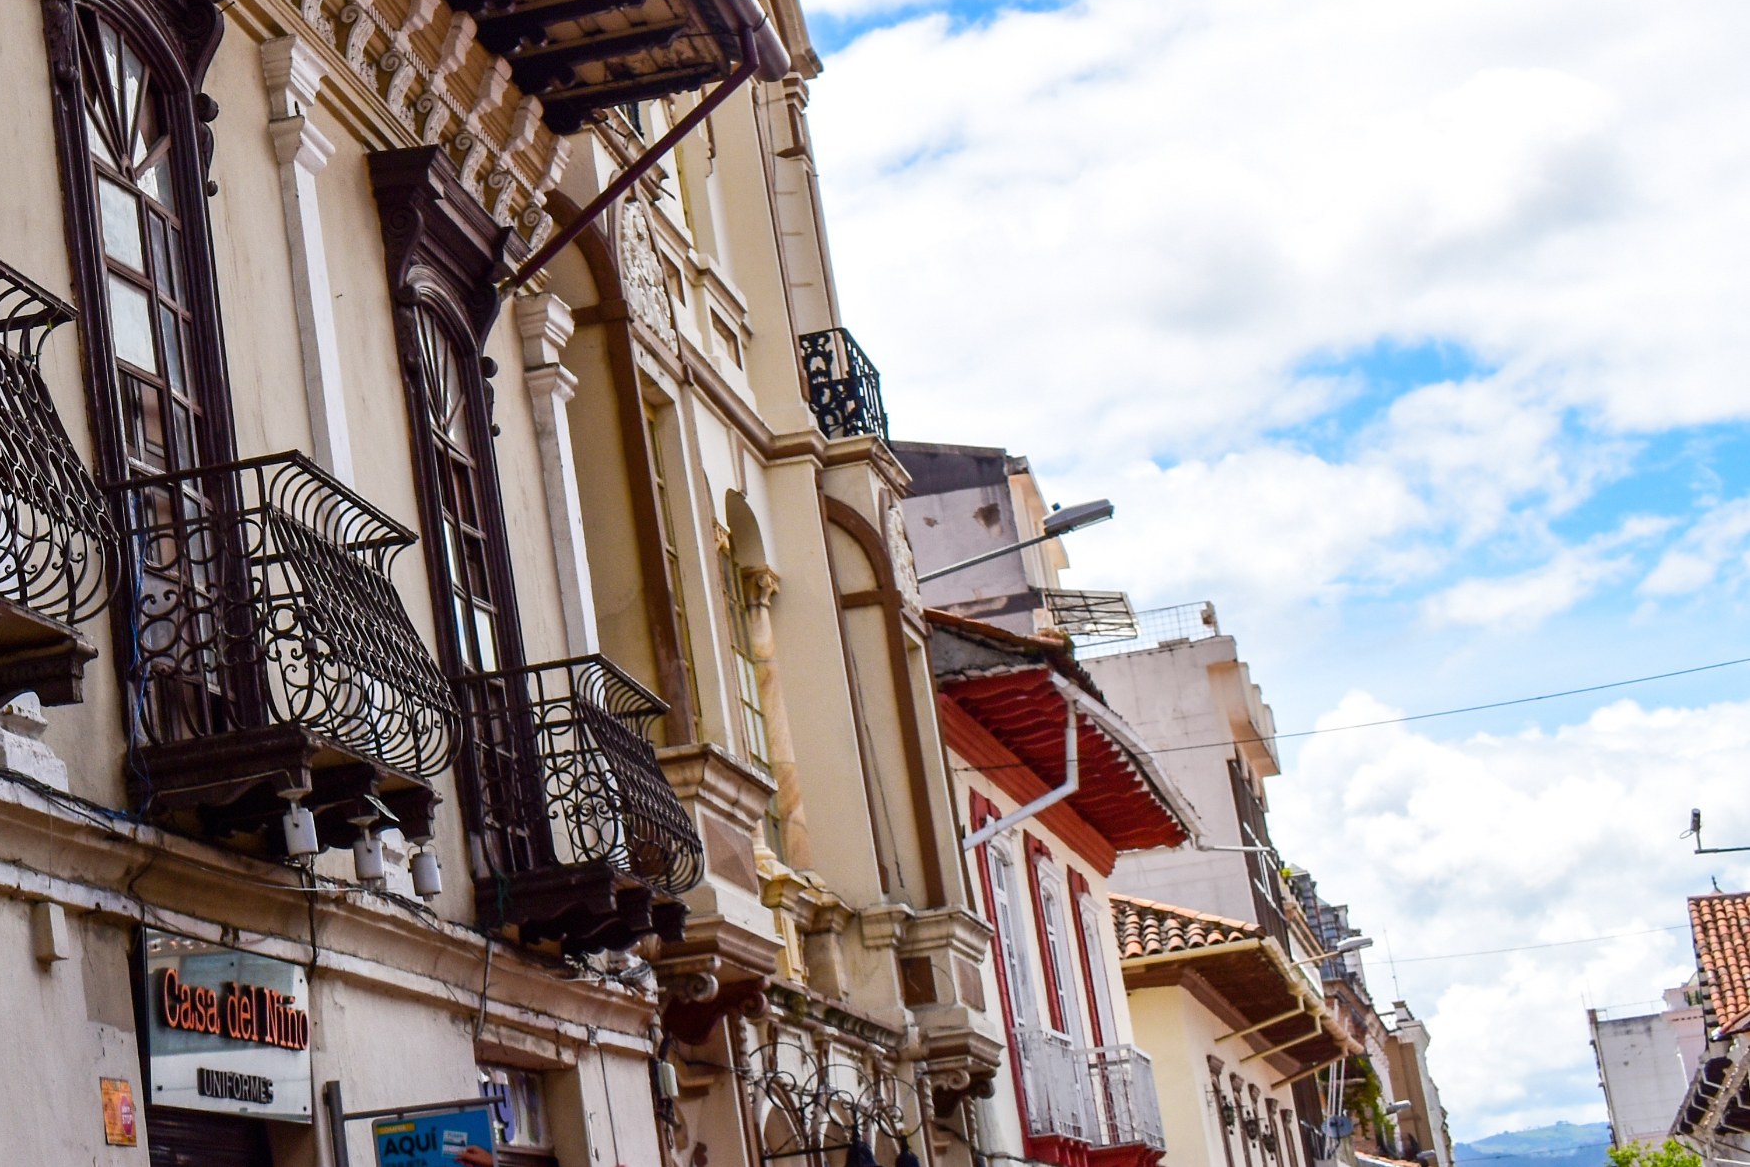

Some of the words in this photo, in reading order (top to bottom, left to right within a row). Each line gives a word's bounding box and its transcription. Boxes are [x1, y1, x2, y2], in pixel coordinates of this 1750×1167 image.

[164, 968, 221, 1034] Casa
[226, 981, 258, 1042] del
[202, 1068, 274, 1104] UNIFORMES
[384, 1127, 437, 1157] AQUÍ
